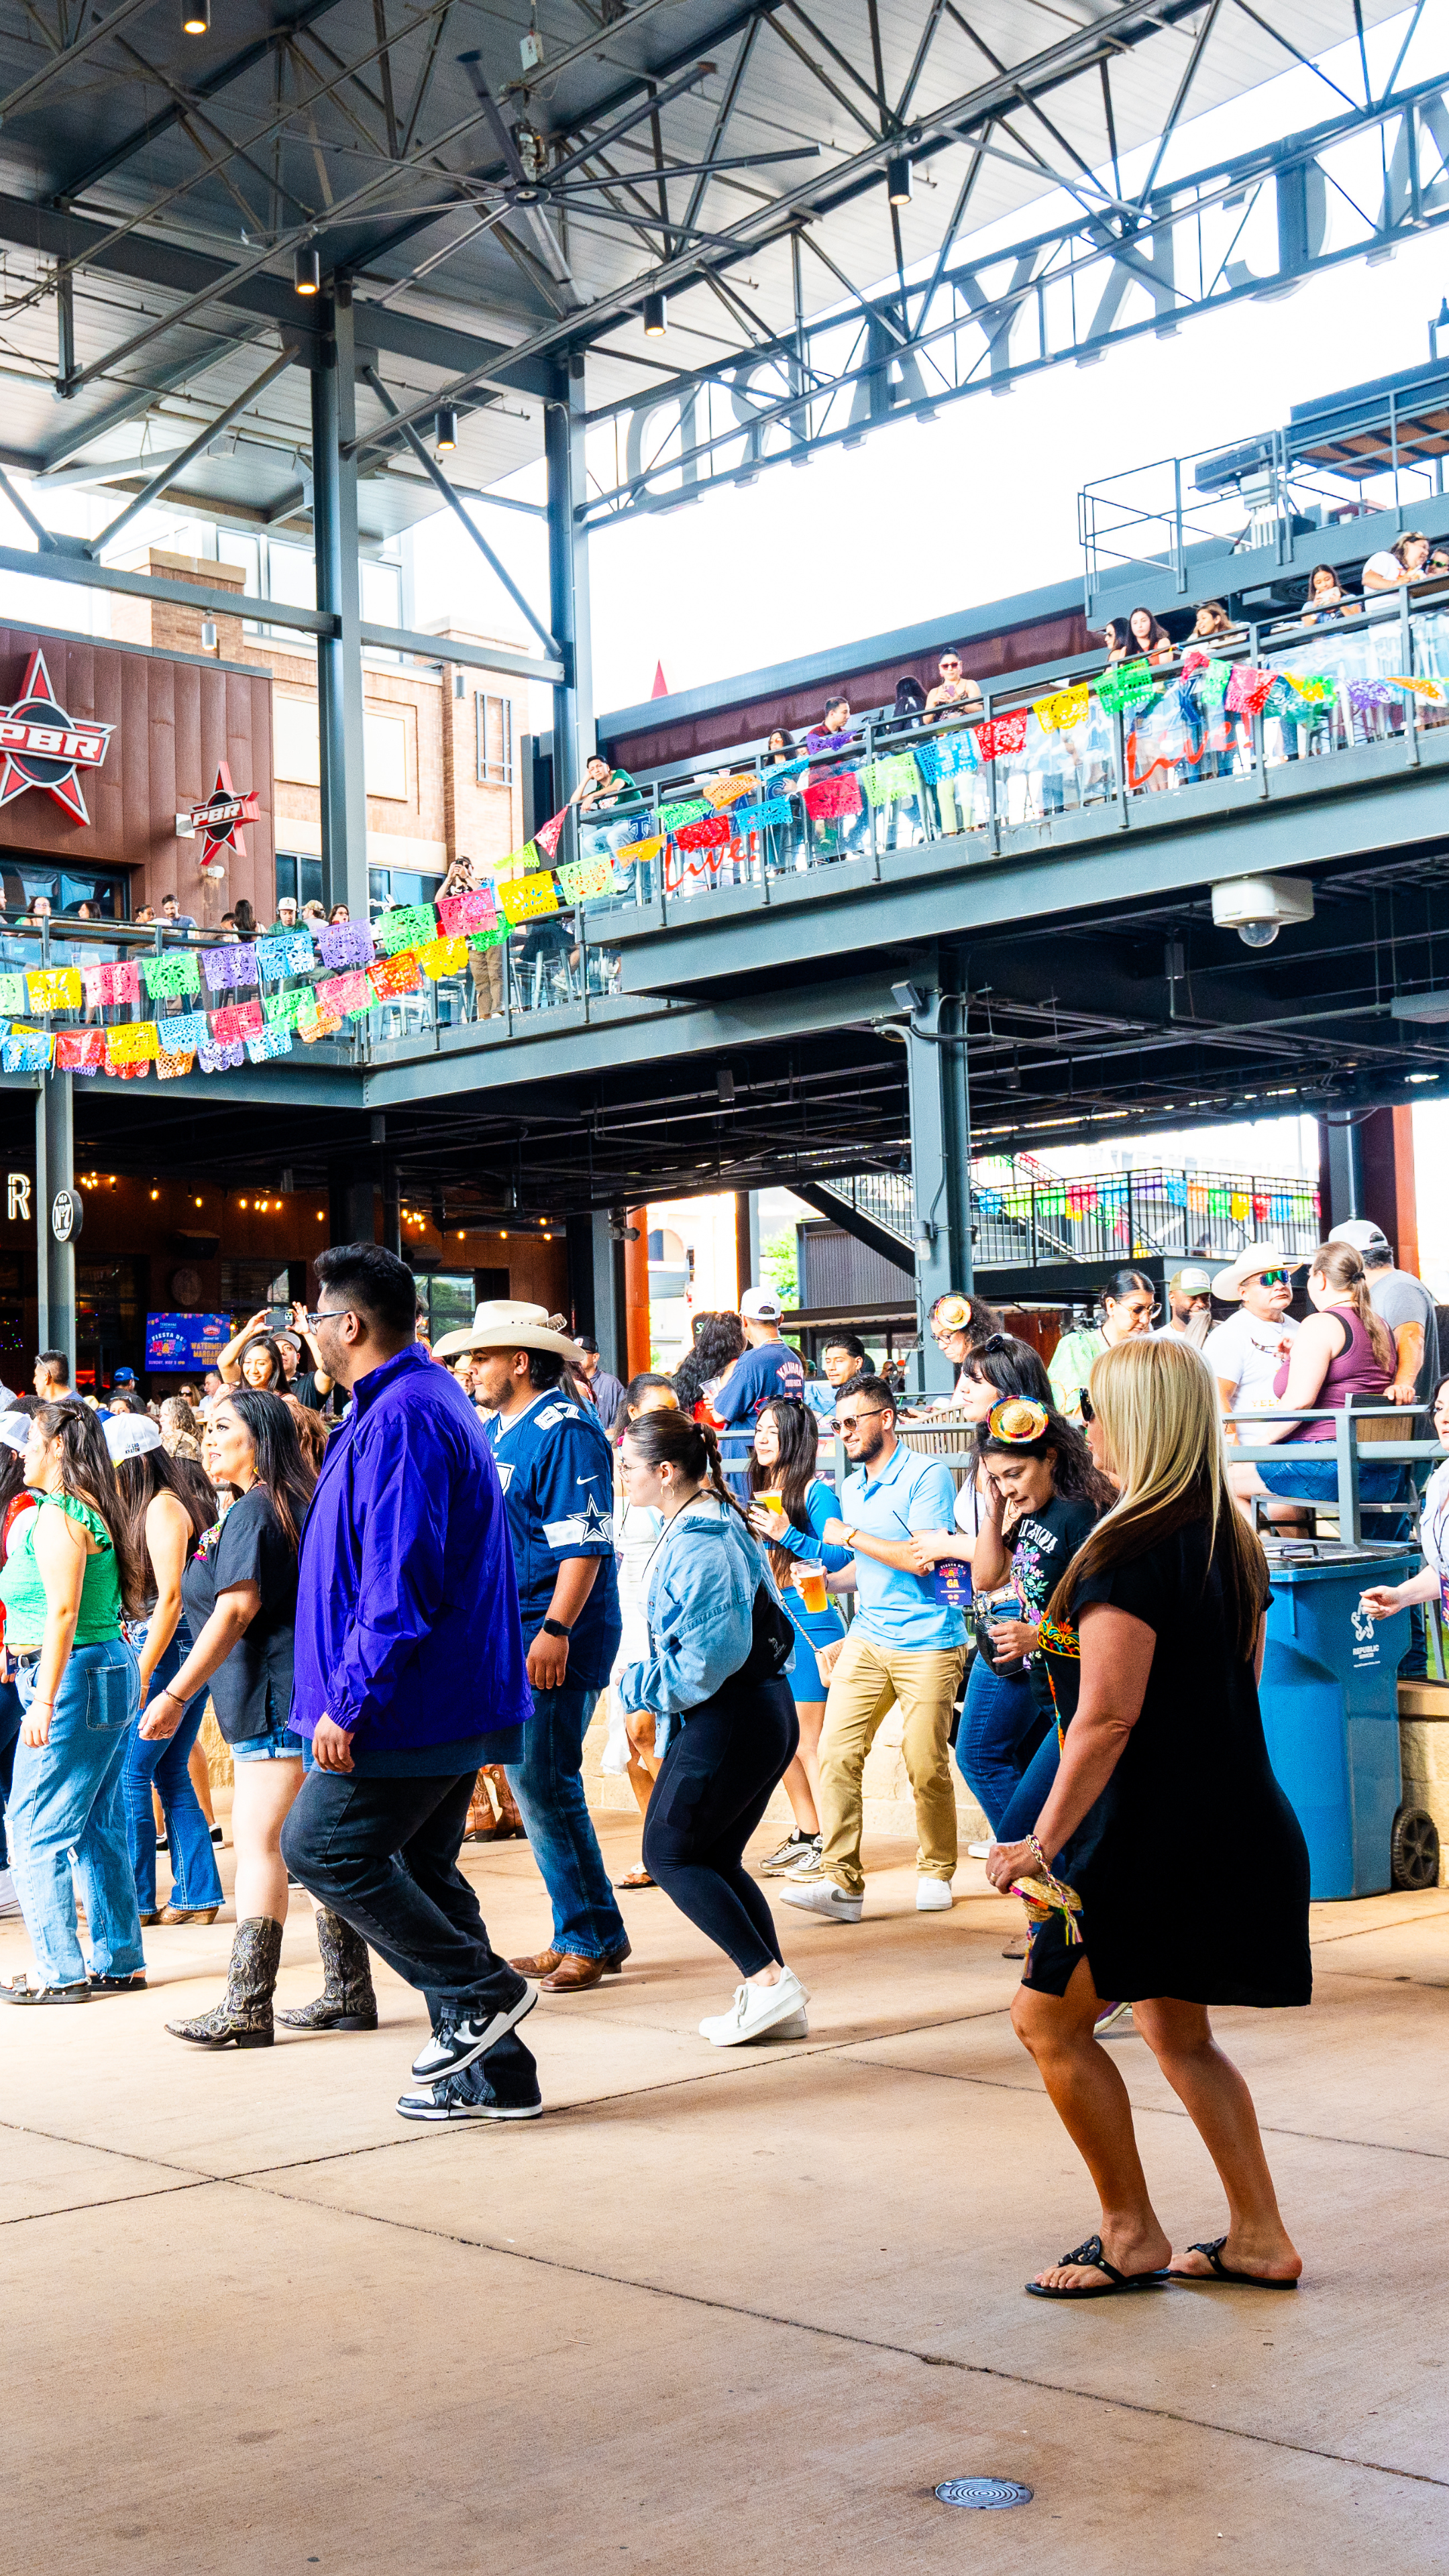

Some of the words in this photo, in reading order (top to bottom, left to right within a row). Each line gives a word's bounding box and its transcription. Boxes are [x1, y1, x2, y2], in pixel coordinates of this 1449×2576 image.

[0, 724, 101, 761] PBR
[193, 802, 241, 827] PBR
[665, 831, 757, 893] Live!
[7, 1173, 31, 1220] R
[58, 1194, 68, 1204] OLD
[152, 1332, 174, 1342] FIESTA
[175, 1334, 184, 1342] DE
[153, 1339, 183, 1354] MAYO
[533, 1402, 581, 1431] 87
[946, 1578, 960, 1589] GA
[1352, 1644, 1380, 1656] REPUBLIC
